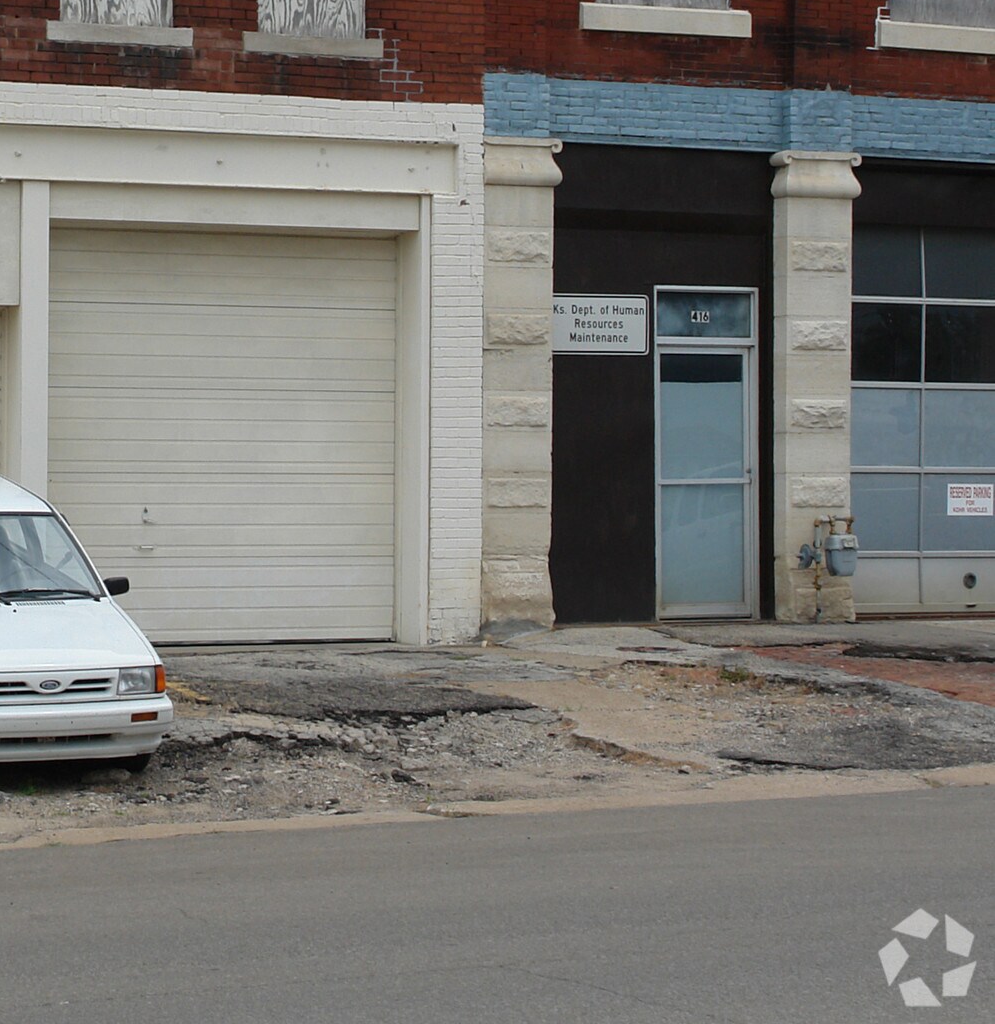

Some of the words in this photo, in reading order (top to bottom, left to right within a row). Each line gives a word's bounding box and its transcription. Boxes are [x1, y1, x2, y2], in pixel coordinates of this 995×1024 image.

[553, 304, 567, 315] Ks.
[571, 304, 596, 317] Dept.
[600, 304, 609, 315] of
[612, 305, 645, 316] Human
[691, 311, 709, 322] 416
[574, 318, 624, 329] Resources
[569, 332, 629, 343] Maintenance
